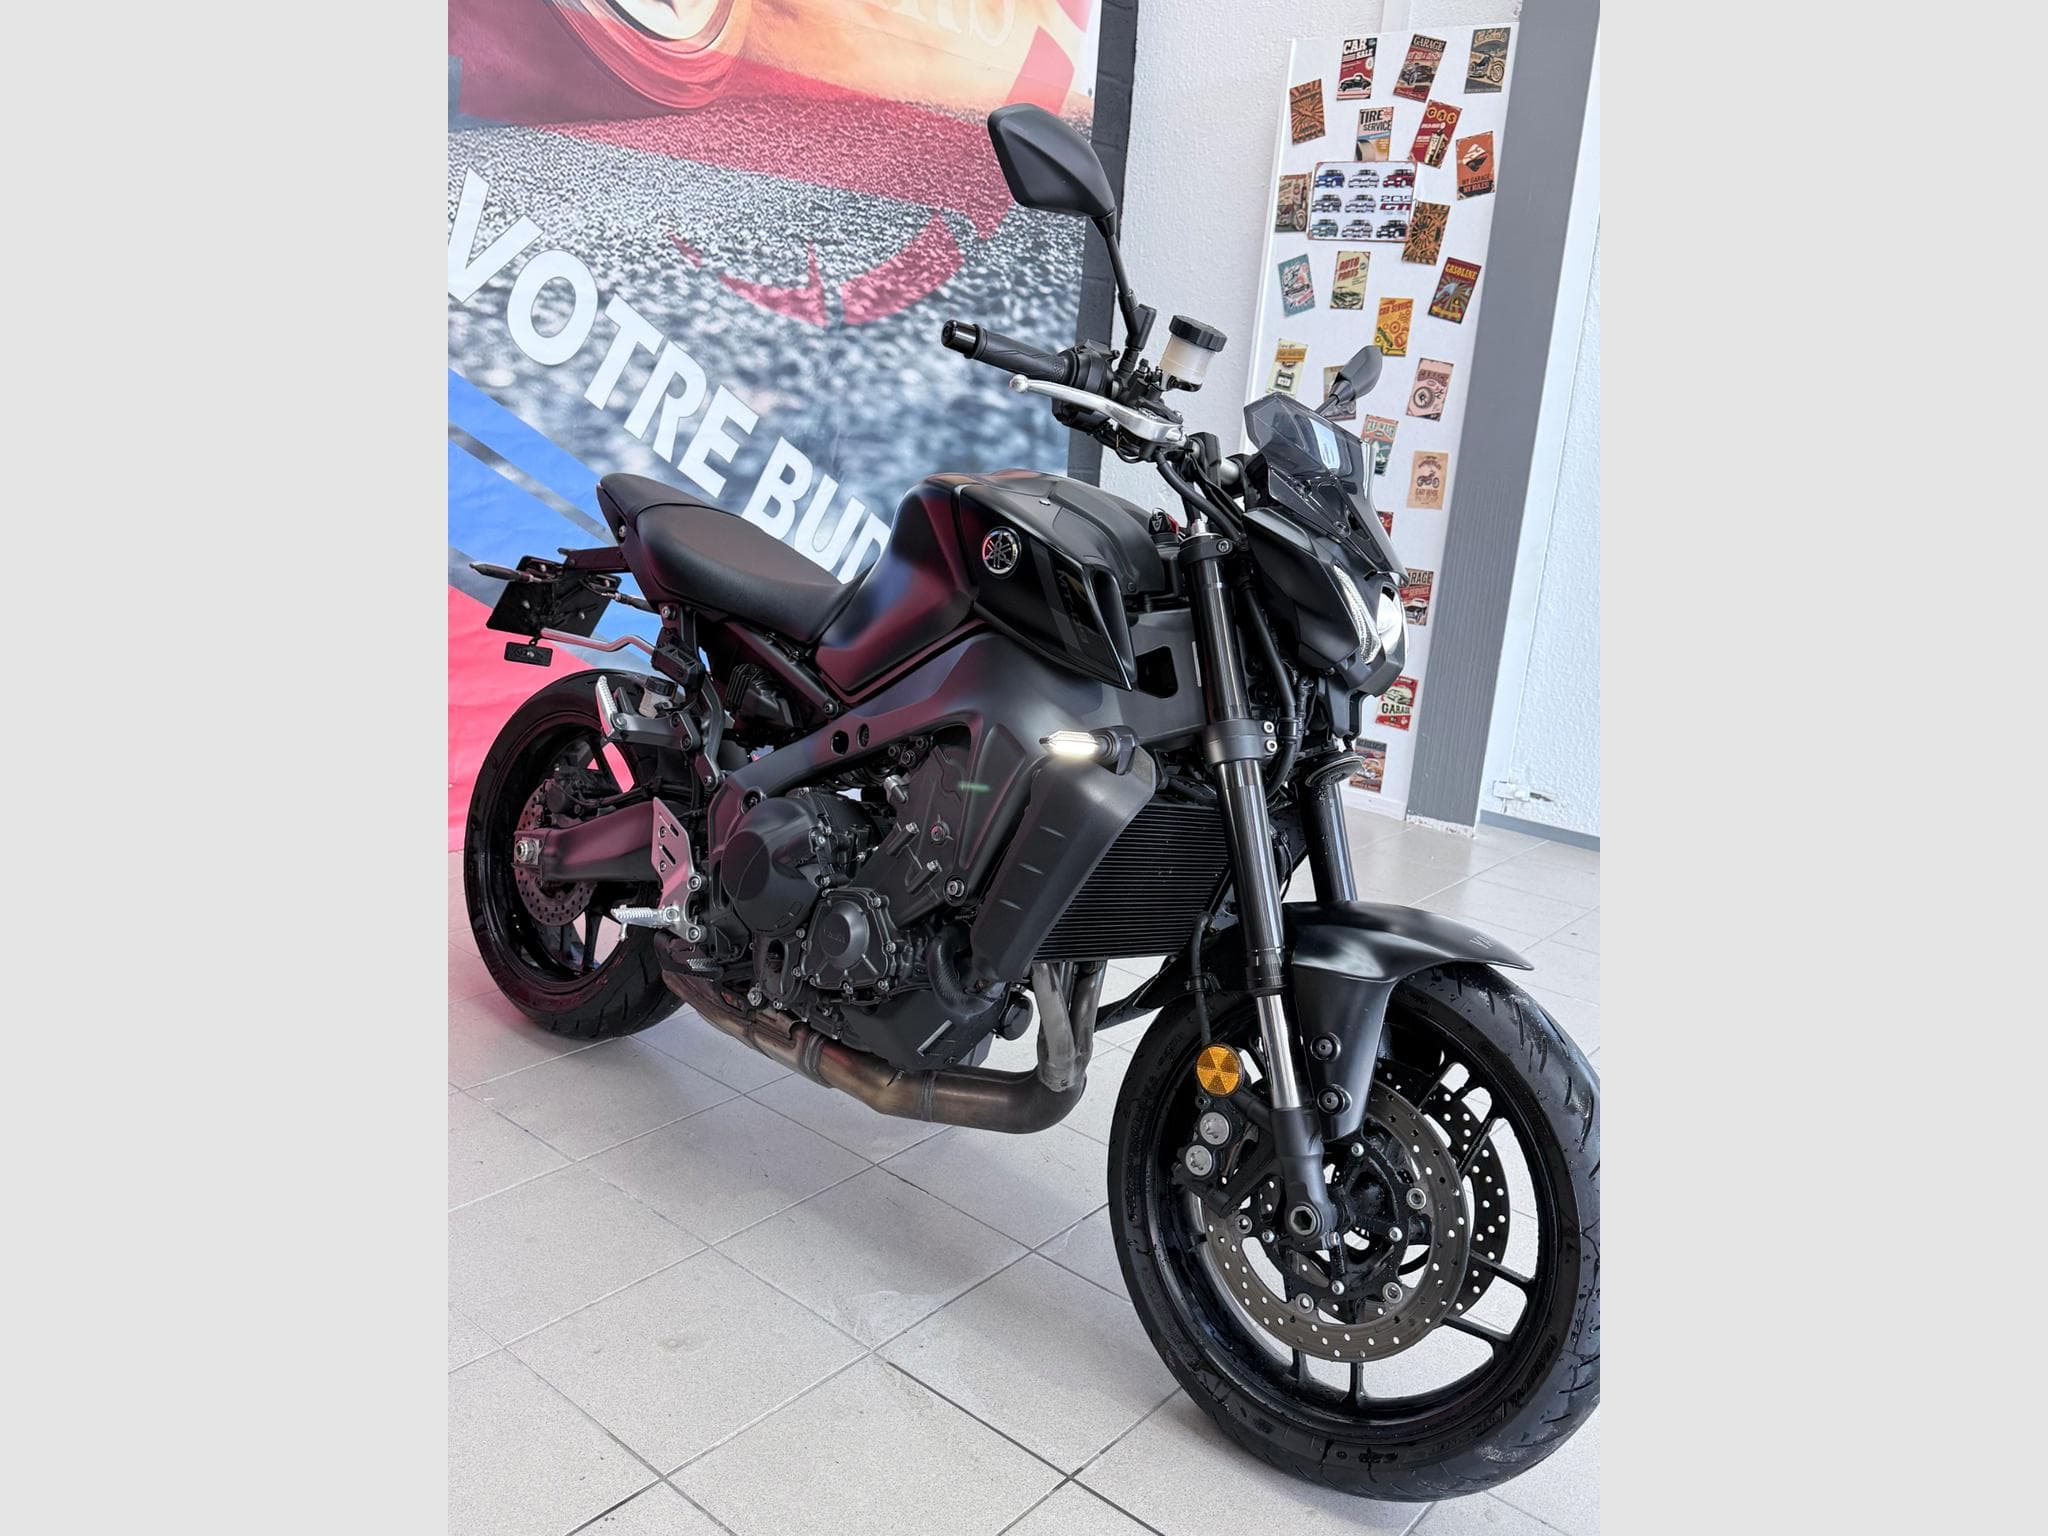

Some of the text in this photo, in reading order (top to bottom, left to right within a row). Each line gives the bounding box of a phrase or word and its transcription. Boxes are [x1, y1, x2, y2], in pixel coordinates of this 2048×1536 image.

[1343, 39, 1368, 54] CAR
[1413, 36, 1443, 52] GARAGE
[1356, 48, 1374, 60] SALE
[1360, 109, 1384, 125] TIRE
[1428, 107, 1457, 123] GAS
[1363, 119, 1392, 132] SERVICE
[1339, 256, 1360, 271] AUTO
[1445, 263, 1478, 280] GASOLINE
[448, 167, 760, 498] VOTRE
